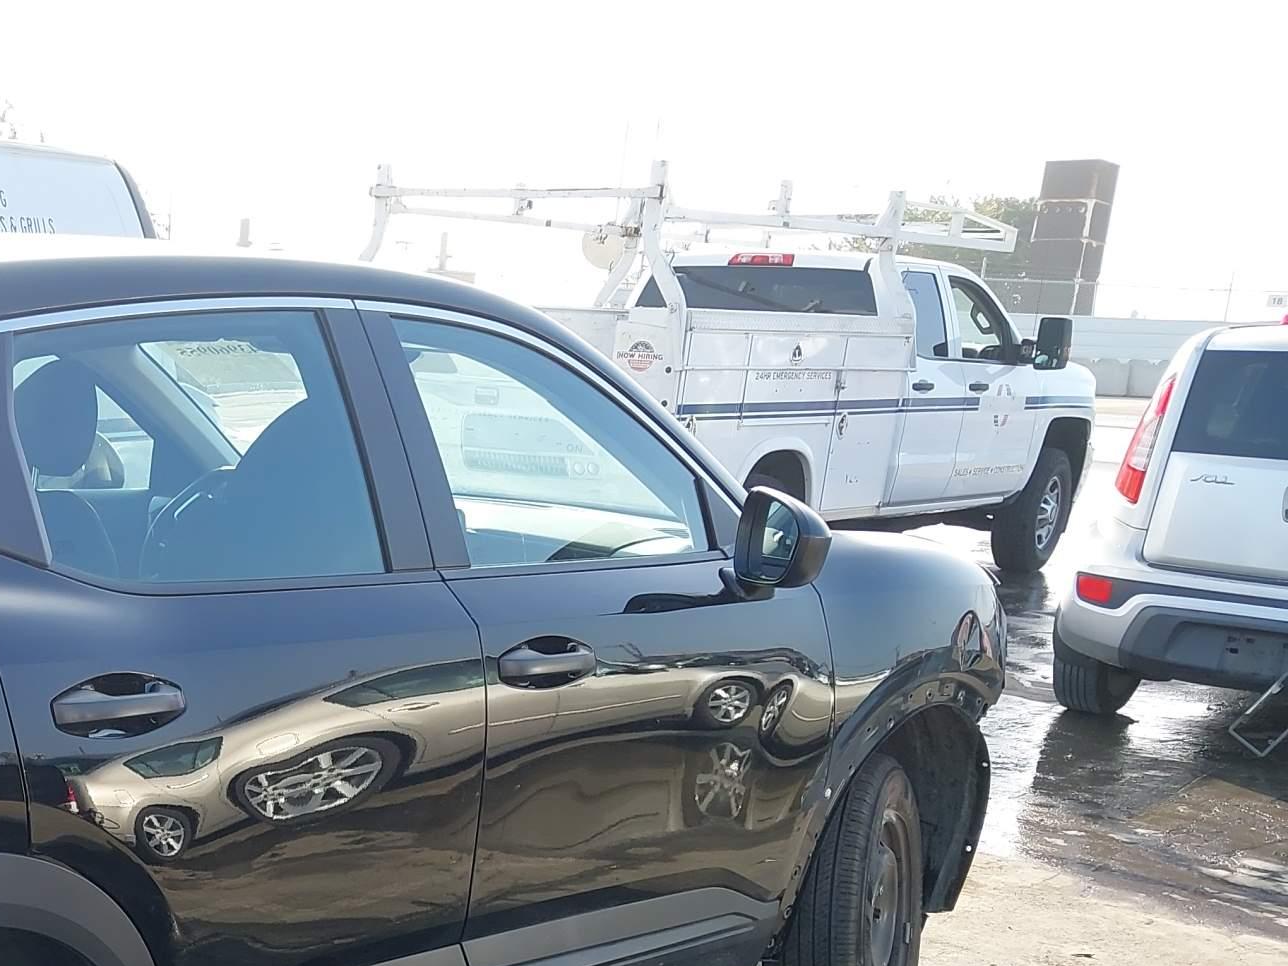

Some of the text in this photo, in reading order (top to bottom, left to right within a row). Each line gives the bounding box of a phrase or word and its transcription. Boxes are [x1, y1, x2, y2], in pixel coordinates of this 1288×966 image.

[617, 351, 664, 361] NOW HIRING
[755, 371, 832, 381] 24HR EMERGENCY SERVICES
